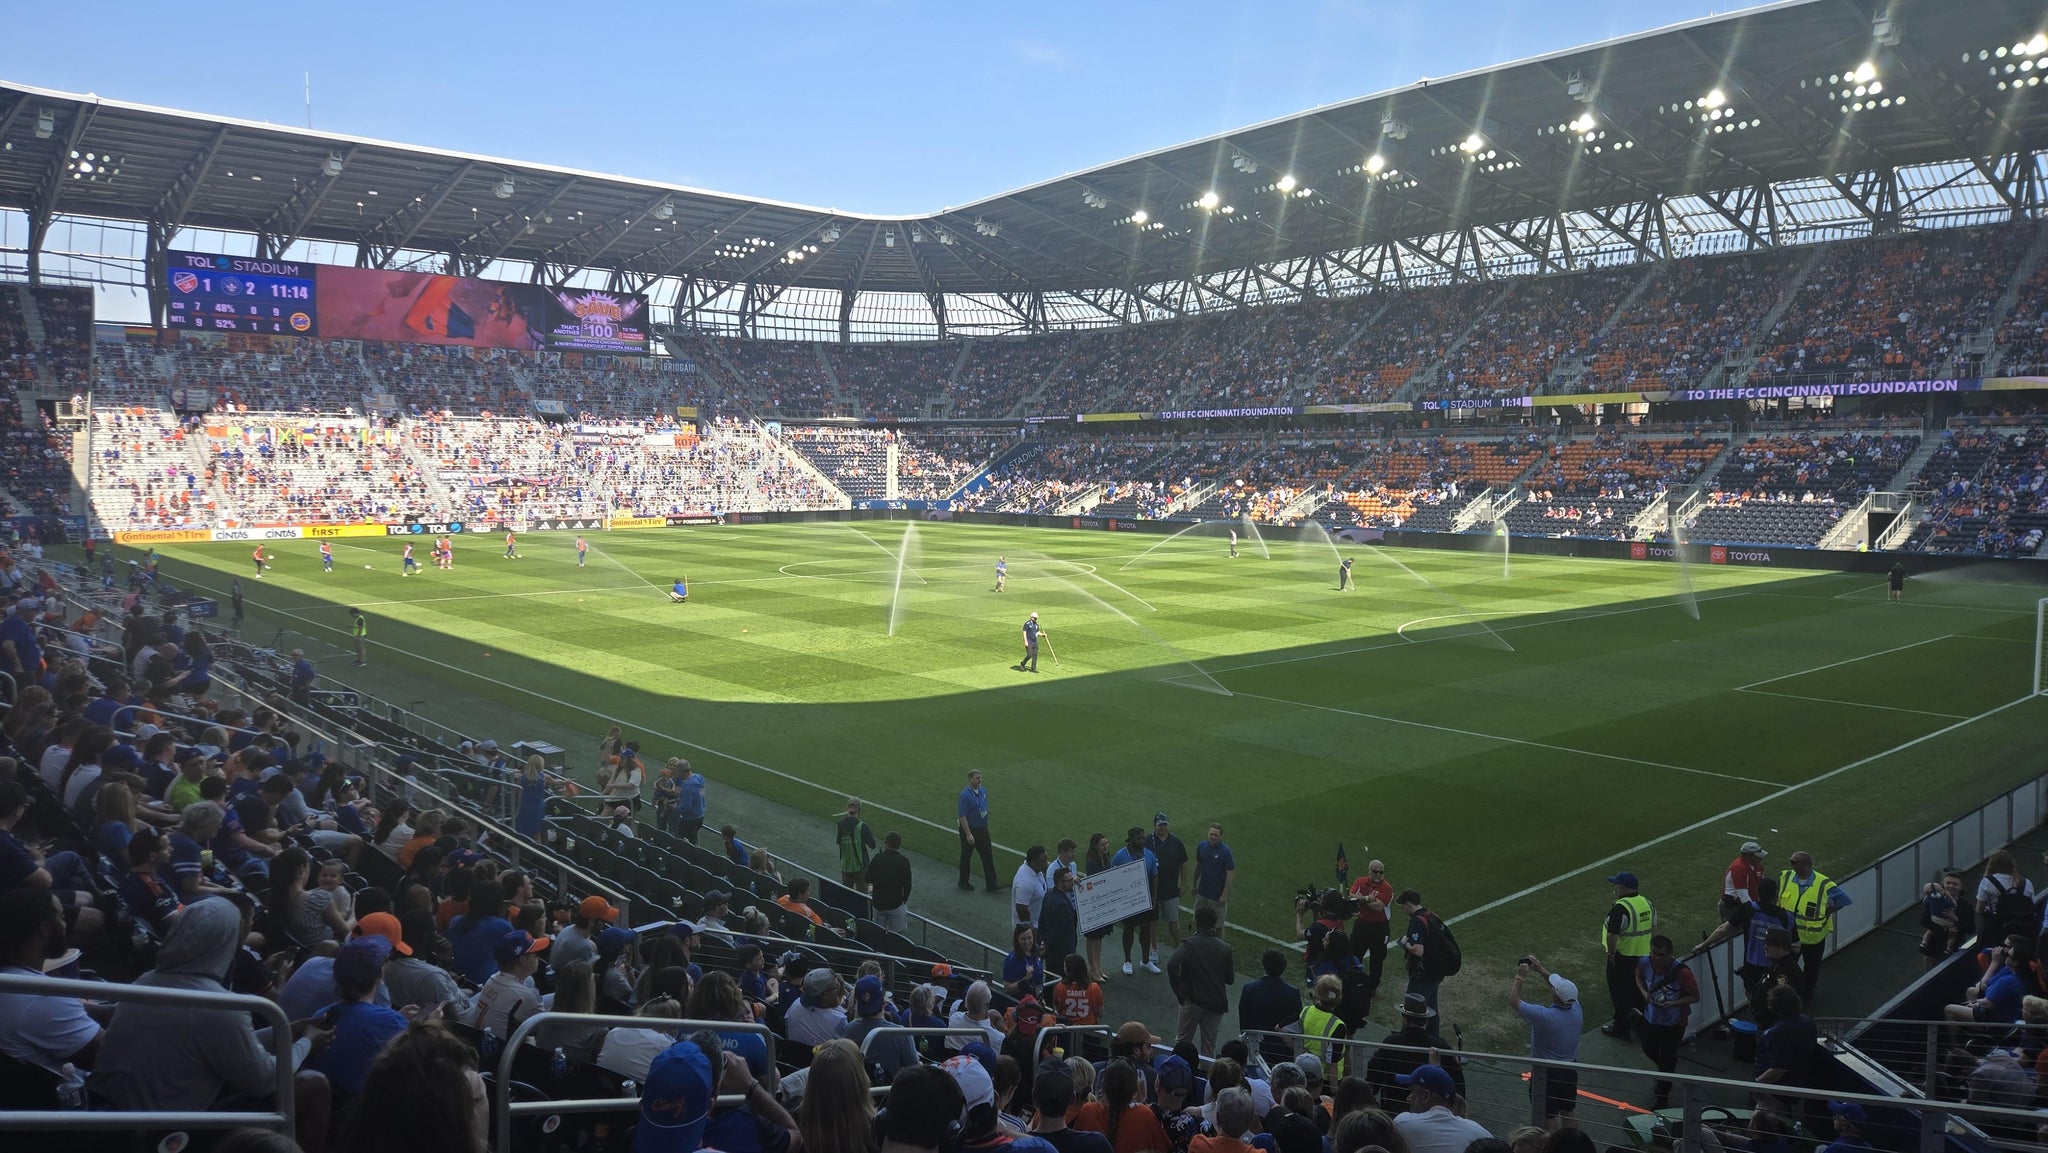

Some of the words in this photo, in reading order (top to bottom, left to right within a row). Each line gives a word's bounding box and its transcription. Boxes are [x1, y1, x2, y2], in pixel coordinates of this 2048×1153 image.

[186, 256, 215, 268] TQL
[234, 260, 298, 276] STADIUM
[203, 278, 211, 292] 1
[246, 282, 255, 295] 2
[271, 284, 308, 299] 11:14
[195, 302, 200, 310] 7
[216, 304, 235, 313] 48%
[576, 302, 622, 320] SAVE
[196, 318, 202, 326] 9
[216, 319, 236, 329] 52%
[273, 324, 280, 332] 4
[584, 324, 612, 338] $100
[1687, 390, 1706, 400] TO
[1708, 389, 1736, 400] THE
[1739, 388, 1755, 398] FC
[1758, 384, 1845, 398] CINCINNATI
[1850, 380, 1958, 394] FOUNDATION
[1422, 401, 1440, 410] TQL
[1450, 399, 1492, 408] STADIUM
[1501, 398, 1521, 407] 11:14
[1162, 411, 1172, 419] TO
[1173, 410, 1185, 418] THE
[1187, 410, 1196, 418] FC
[1197, 408, 1239, 418] CINCINNATI
[1241, 407, 1293, 416] FOUNDATION
[428, 525, 449, 534] TQL
[610, 519, 642, 528] Continental
[122, 532, 175, 542] Continental
[183, 531, 205, 539] Tire
[388, 526, 411, 535] TQL
[1730, 552, 1770, 562] TOYOTA
[1065, 998, 1089, 1018] 25
